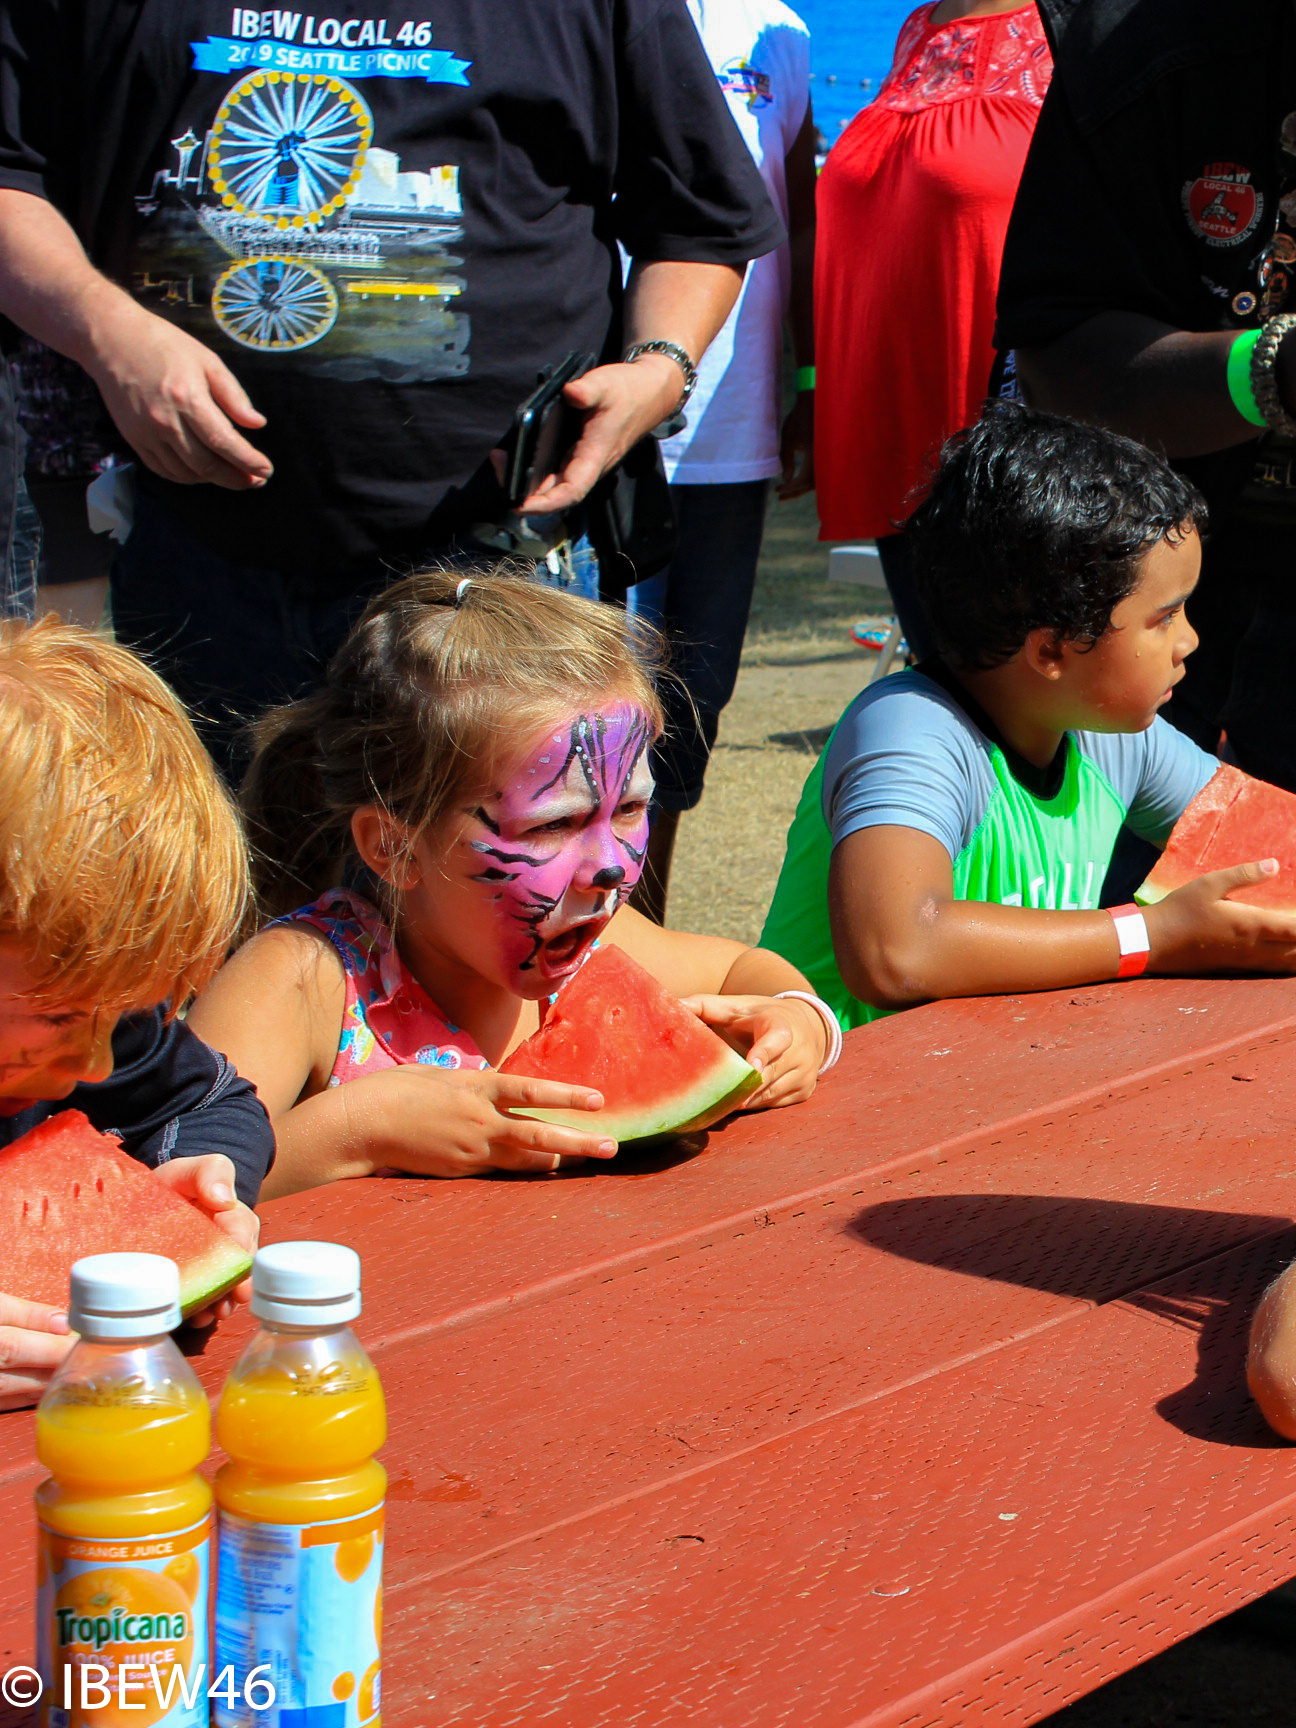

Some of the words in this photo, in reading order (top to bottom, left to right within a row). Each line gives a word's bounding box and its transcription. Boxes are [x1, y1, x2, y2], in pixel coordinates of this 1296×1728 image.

[231, 8, 302, 41] IBEW
[303, 16, 392, 47] LOCAL
[396, 20, 432, 47] 46
[274, 48, 361, 71] SEATTLE
[366, 53, 432, 71] PICNIC
[1203, 182, 1233, 192] LOCAL
[1198, 220, 1237, 235] SEATTLE
[69, 1544, 129, 1558] ORANGE
[131, 1542, 175, 1557] JUICE
[56, 1607, 187, 1649] Tropicana
[123, 1647, 176, 1666] JUICE
